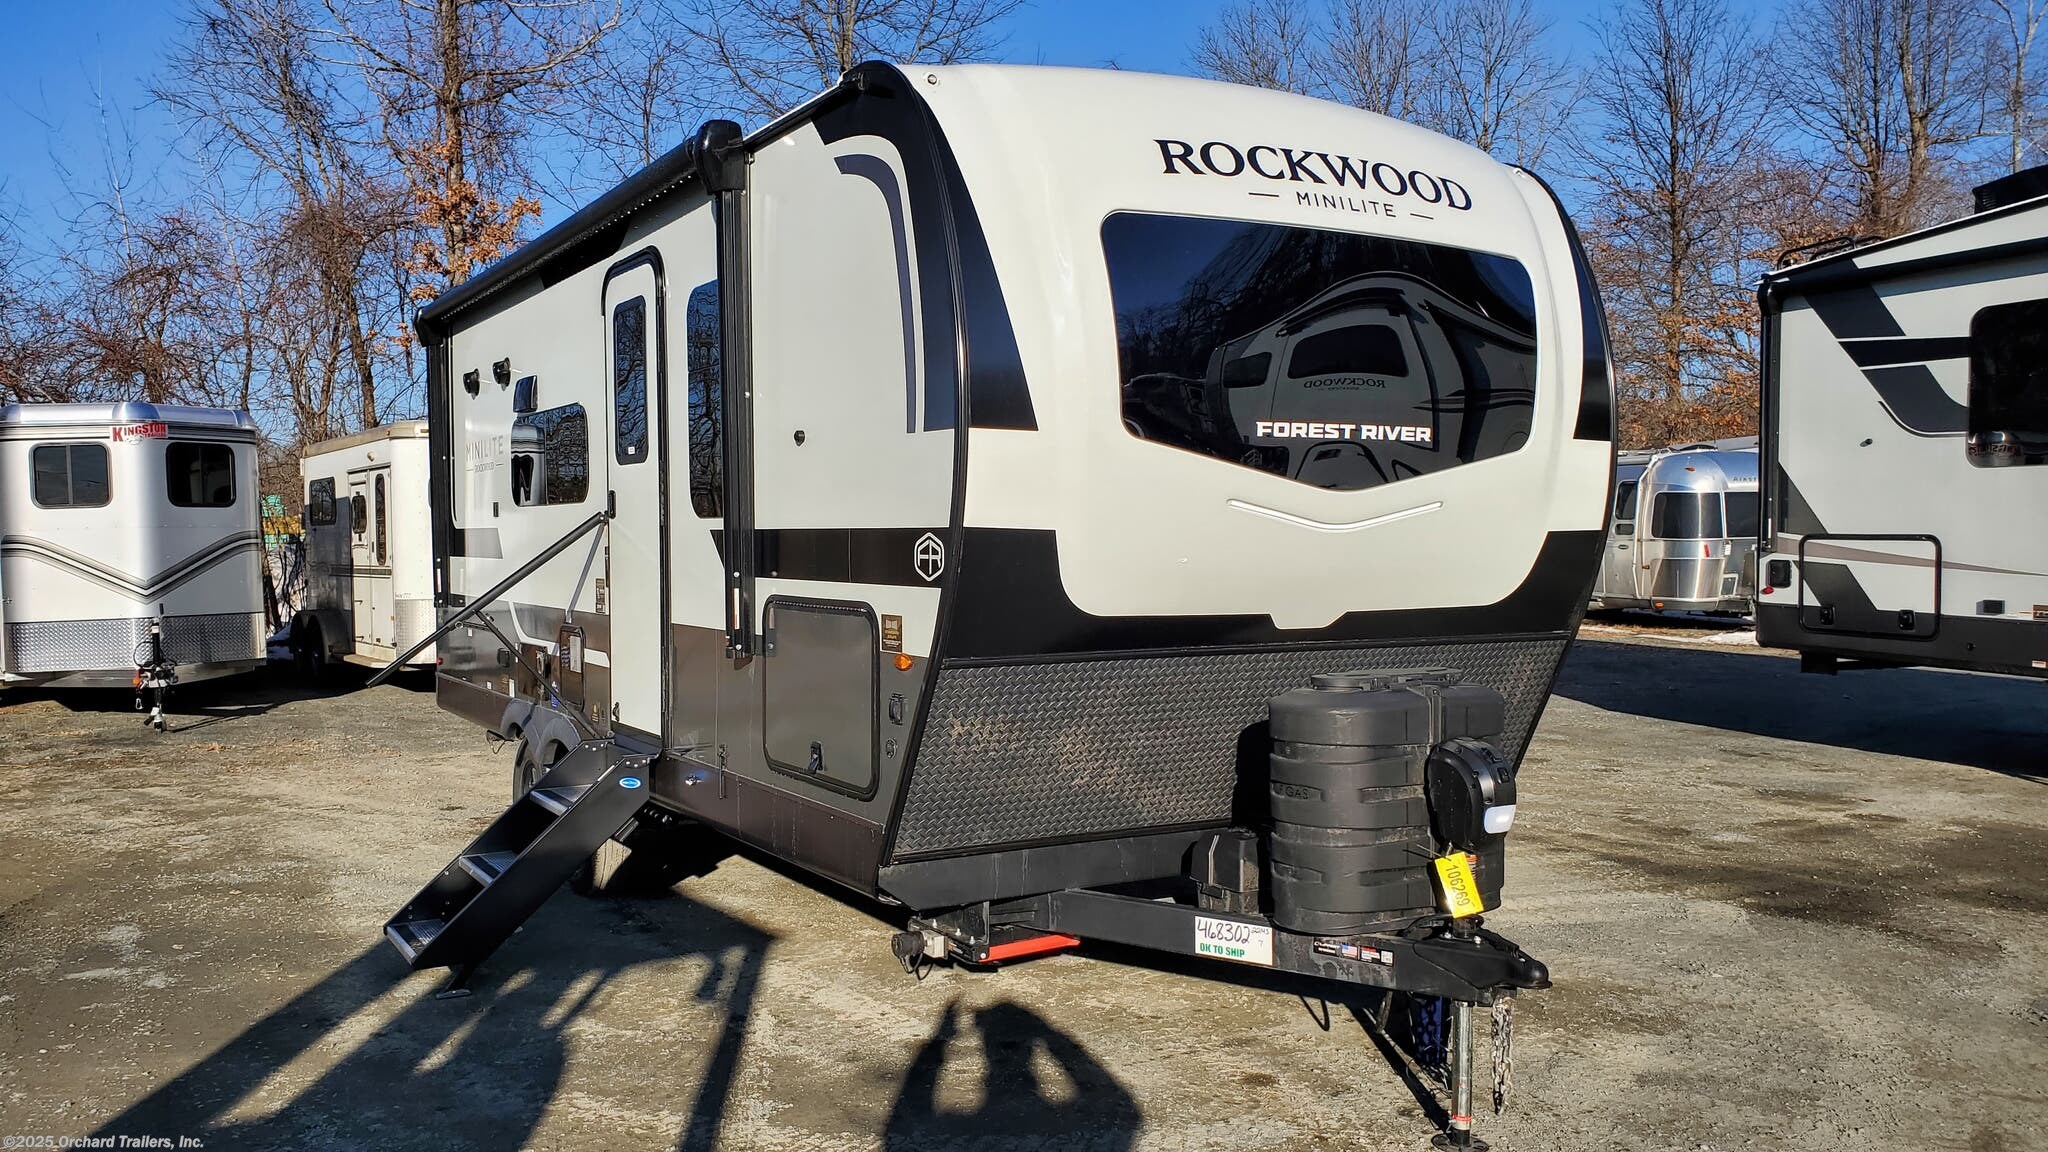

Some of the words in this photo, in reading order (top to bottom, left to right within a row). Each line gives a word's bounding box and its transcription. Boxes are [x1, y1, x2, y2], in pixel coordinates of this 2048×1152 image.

[1153, 139, 1472, 211] ROCKWOOD
[1296, 191, 1396, 217] MINILITE
[112, 423, 166, 441] KINGSTON
[1256, 421, 1357, 439] FOREST
[1360, 424, 1432, 442] RIVER
[465, 435, 503, 461] MINILITE
[1445, 864, 1471, 906] 106269
[1197, 919, 1250, 944] 468302
[1200, 943, 1211, 953] OK
[1213, 945, 1223, 954] TO
[1225, 947, 1245, 957] SHIP
